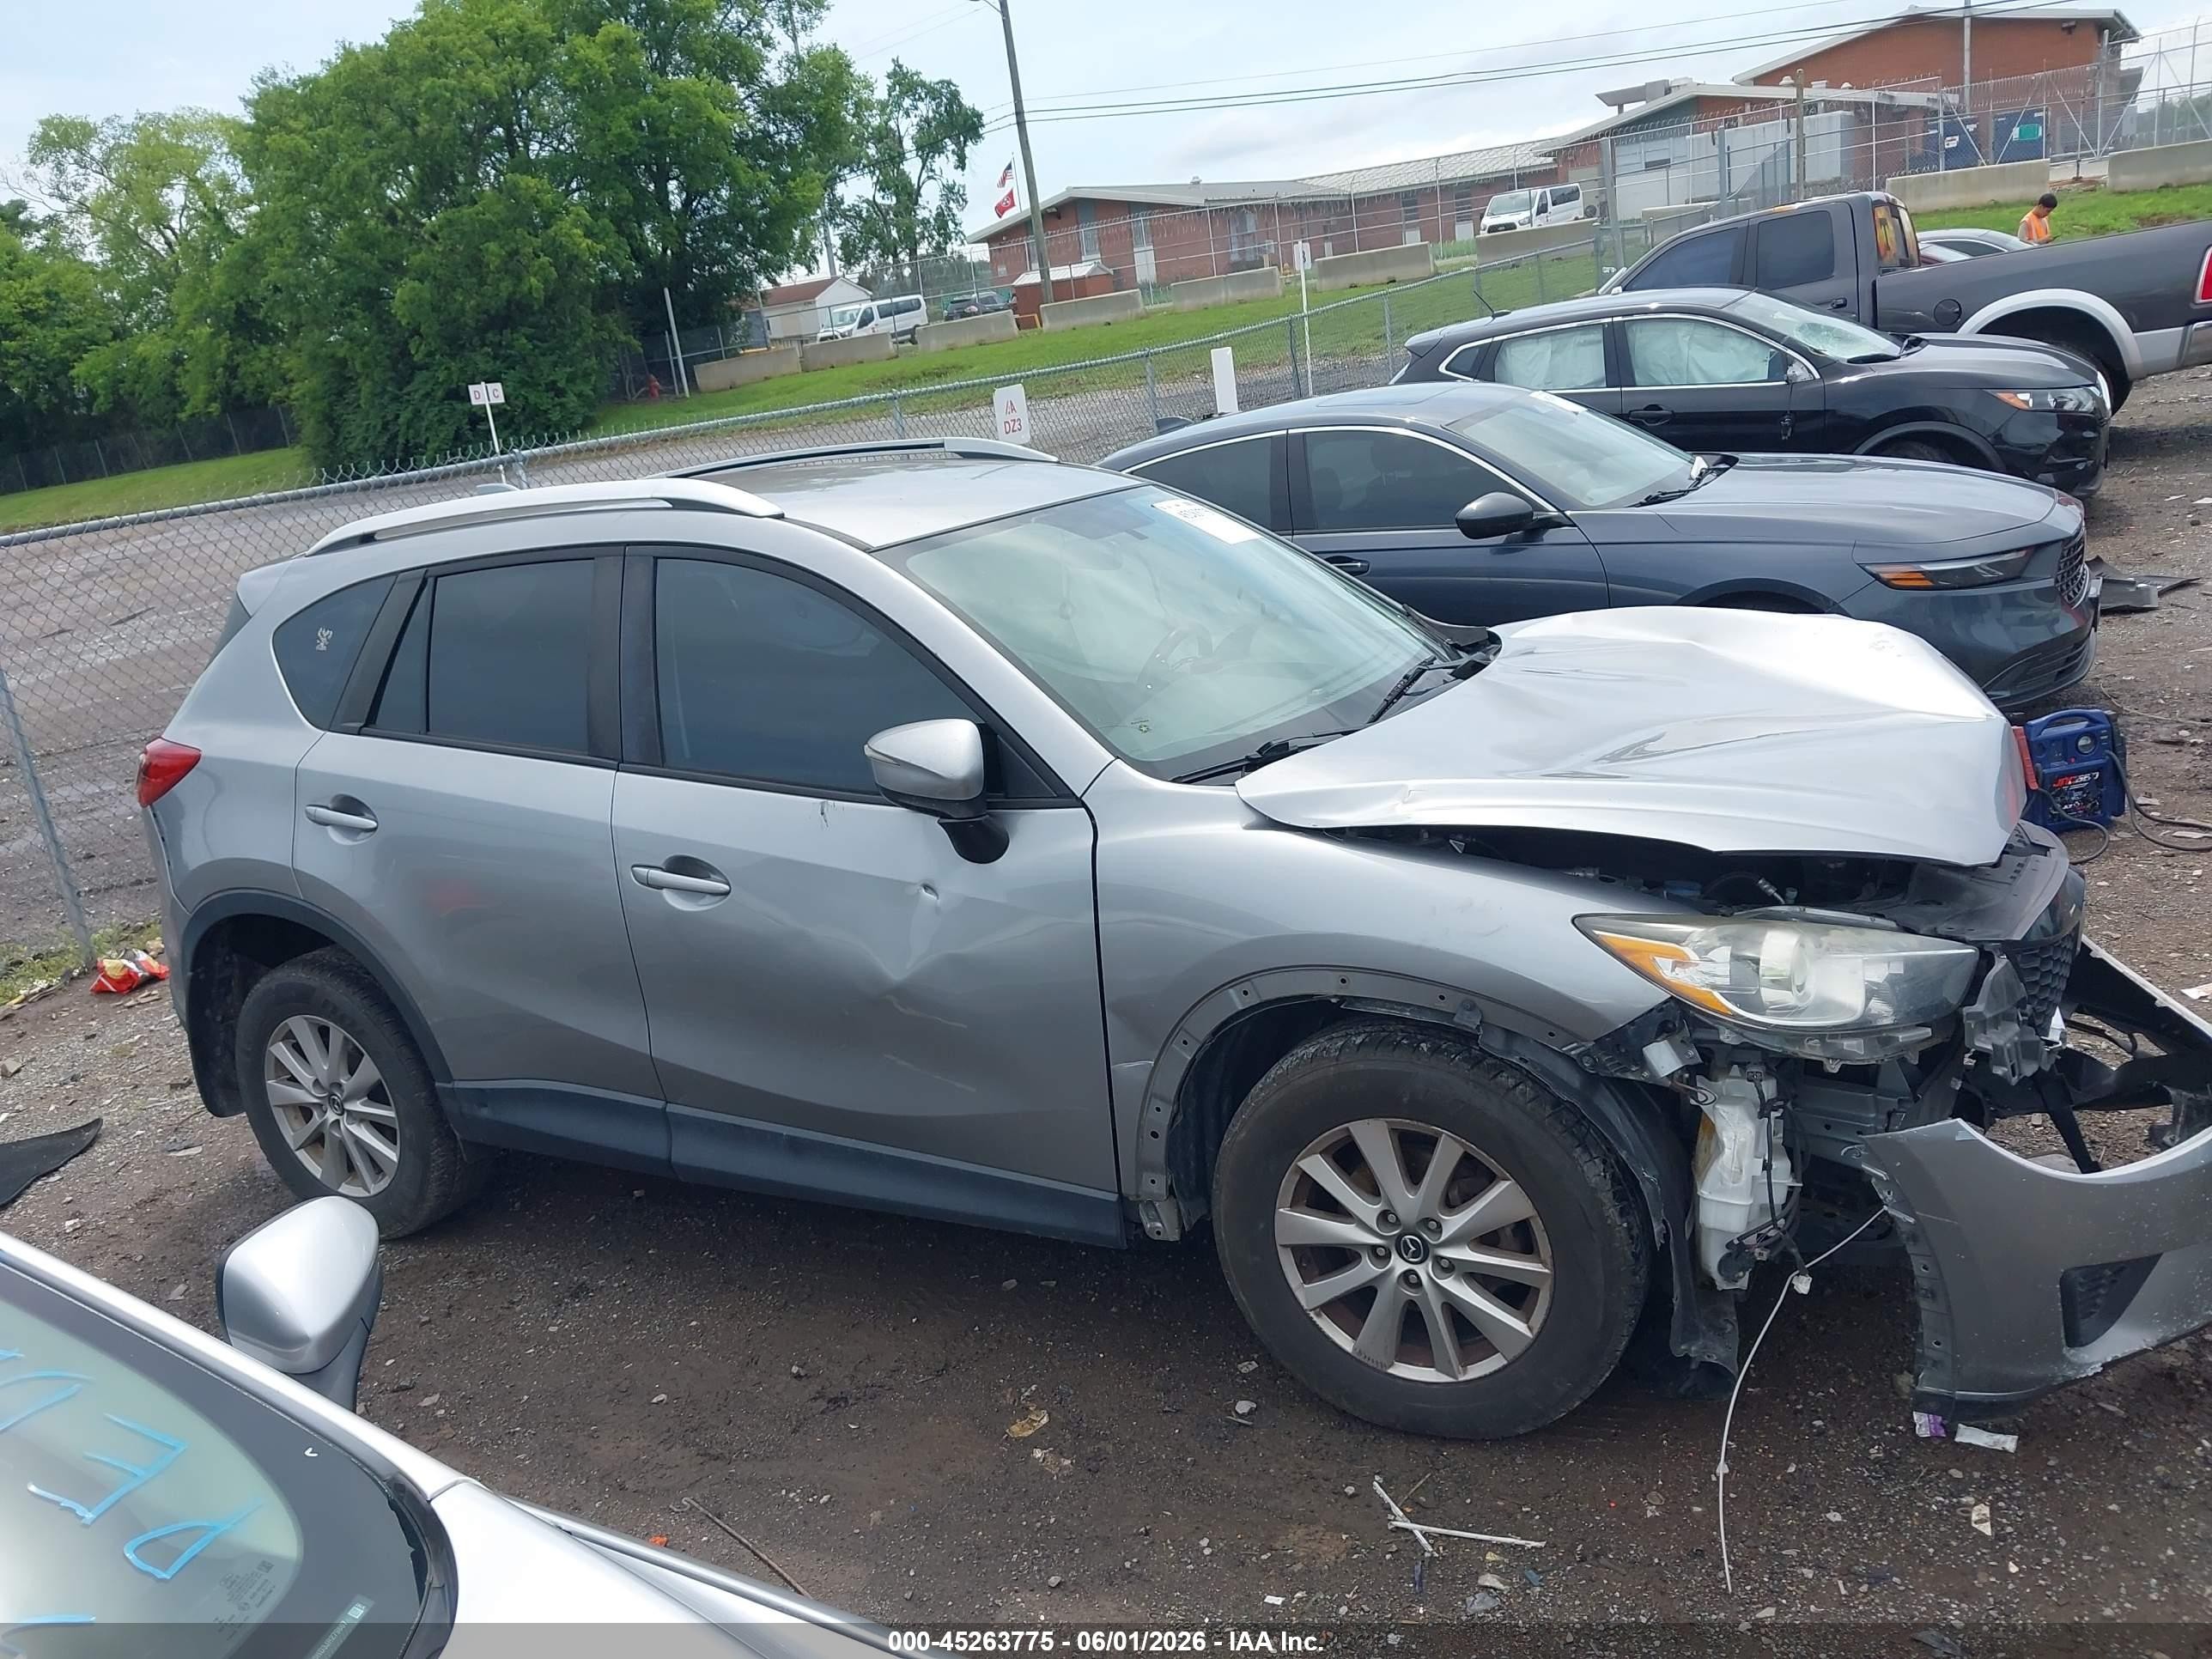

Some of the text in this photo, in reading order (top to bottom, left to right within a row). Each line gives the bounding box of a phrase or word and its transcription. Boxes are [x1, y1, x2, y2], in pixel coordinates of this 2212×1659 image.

[473, 390, 481, 400] D
[492, 388, 500, 398] C
[1003, 417, 1023, 435] DZ3
